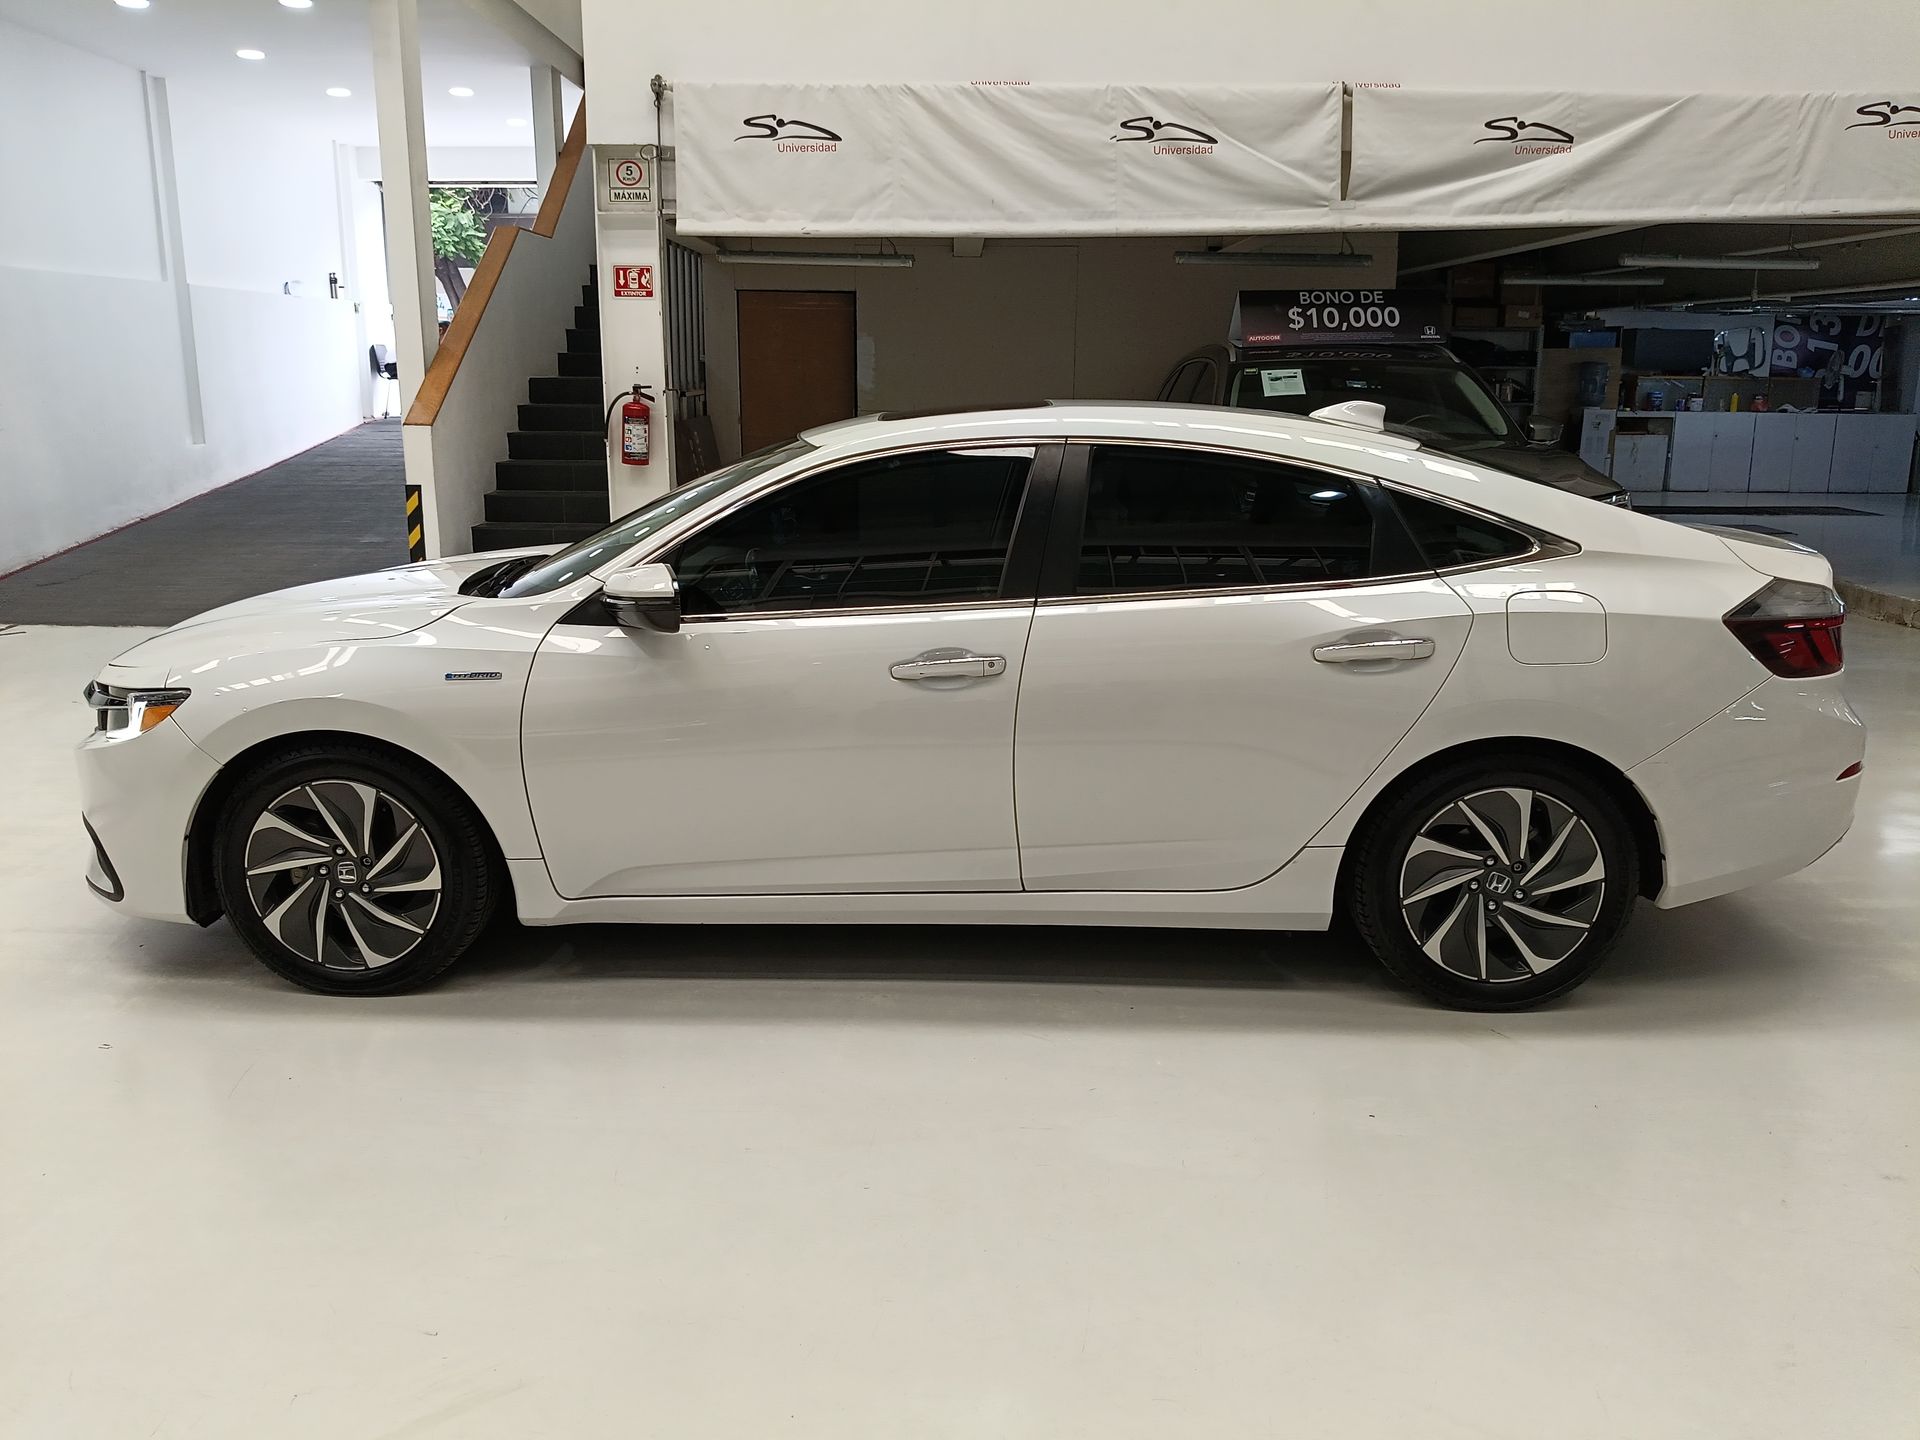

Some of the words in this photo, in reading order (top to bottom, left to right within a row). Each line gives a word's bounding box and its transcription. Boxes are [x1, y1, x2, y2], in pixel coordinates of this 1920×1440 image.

[777, 142, 837, 153] Universidad
[1153, 145, 1213, 155] Universidad
[1514, 145, 1573, 155] Universidad
[625, 165, 633, 176] 5
[613, 190, 648, 200] MÁXIMA
[1300, 291, 1354, 304] BONO
[1361, 291, 1384, 304] DE
[1287, 306, 1400, 331] $10,000
